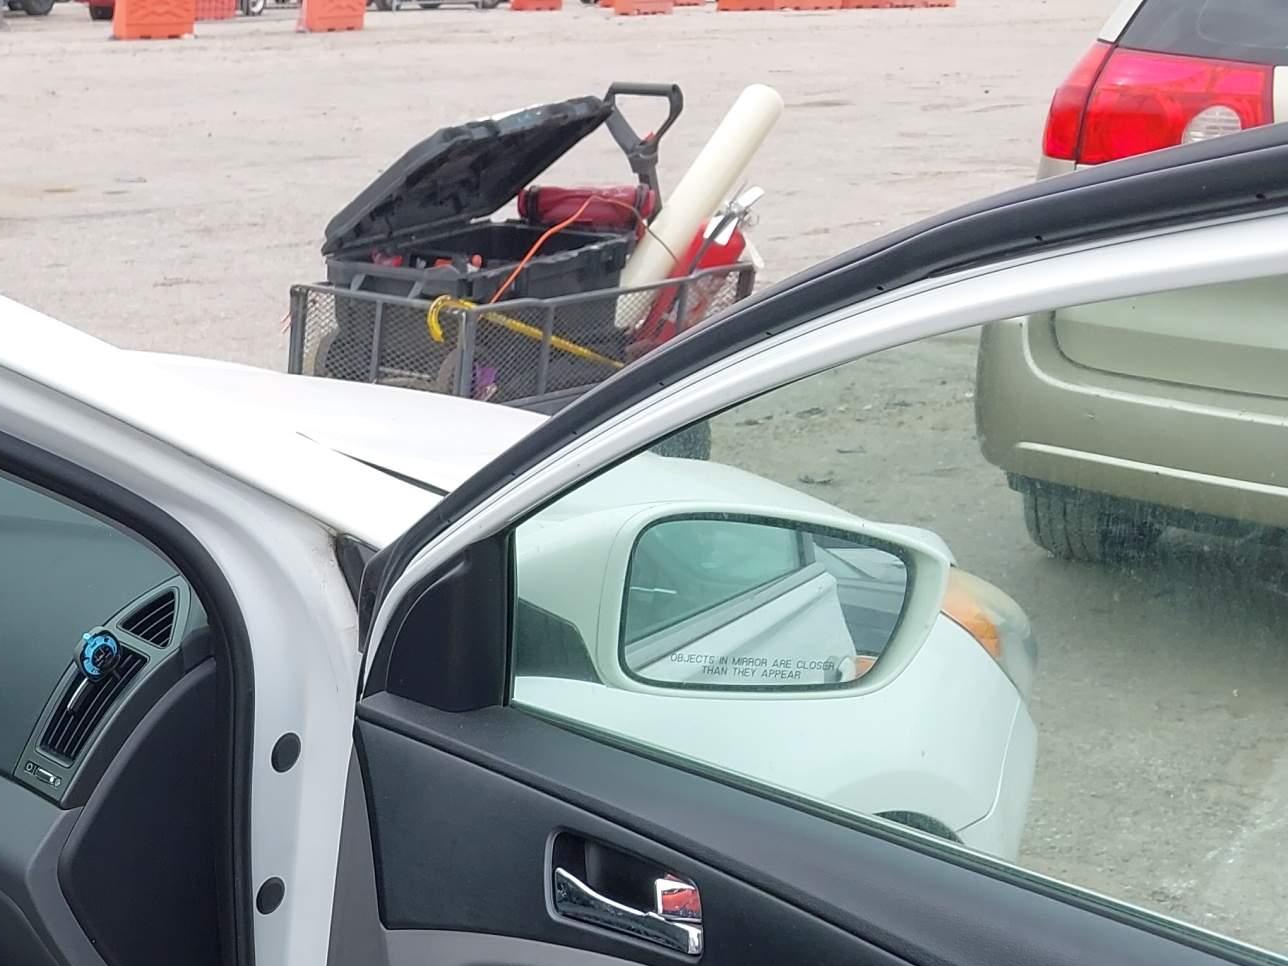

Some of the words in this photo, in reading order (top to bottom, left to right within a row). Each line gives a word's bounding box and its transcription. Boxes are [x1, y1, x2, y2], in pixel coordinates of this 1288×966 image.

[670, 654, 714, 665] OBJECTS
[719, 656, 728, 665] IN
[731, 657, 767, 667] MIRROR
[772, 659, 792, 669] ARE
[796, 661, 835, 671] CLOSER
[702, 665, 728, 676] THAN
[733, 667, 756, 678] THEY
[761, 669, 801, 680] APPEAR
